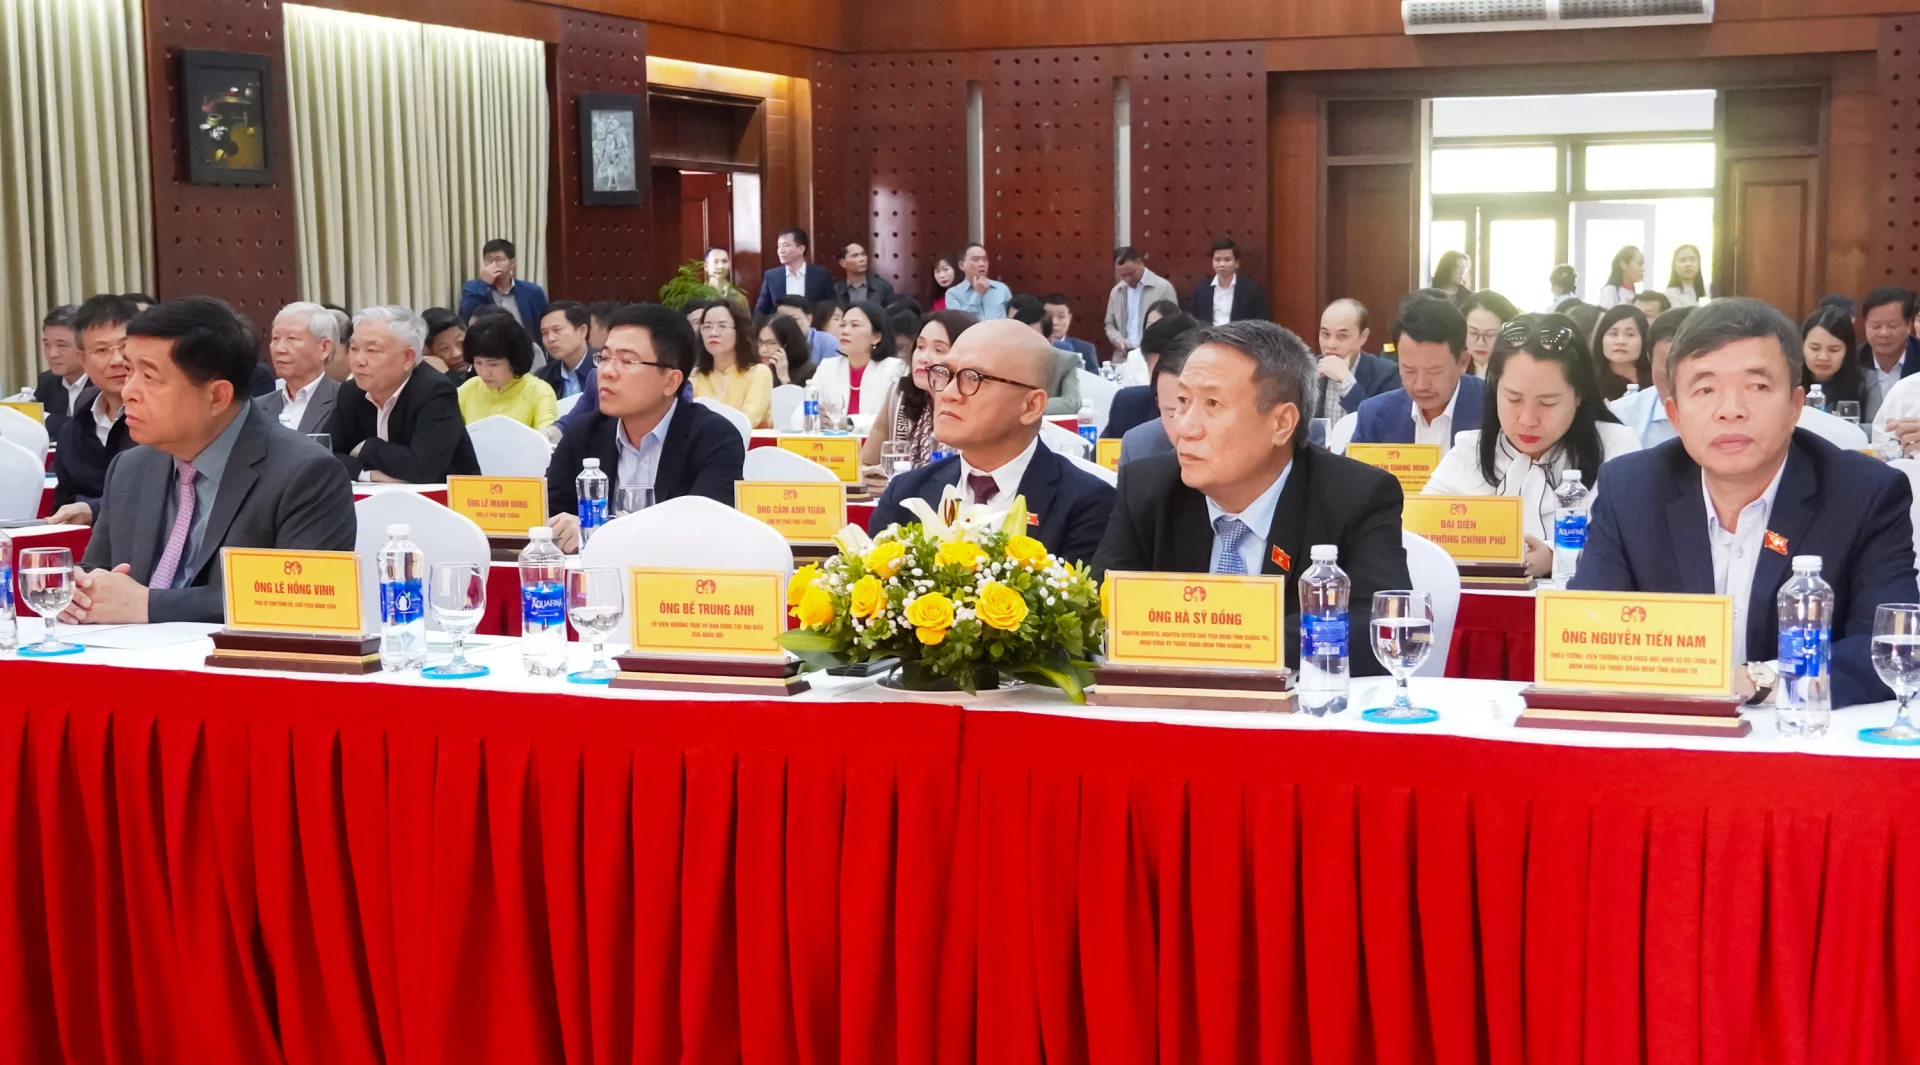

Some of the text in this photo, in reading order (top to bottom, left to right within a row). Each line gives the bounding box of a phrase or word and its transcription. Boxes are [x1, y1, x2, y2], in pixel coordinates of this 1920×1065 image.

[467, 498, 480, 507] ÔNG
[482, 498, 488, 507] LÊ
[757, 504, 771, 513] ÔNG
[1558, 528, 1584, 536] AQUAFINA
[254, 580, 272, 593] ÔNG
[275, 581, 284, 593] LÊ
[314, 585, 334, 596] VINH
[532, 597, 563, 609] AQUAFINA
[659, 600, 754, 616] ÔNG BẾ TRUNG ANH
[1148, 608, 1171, 622] ÔNG
[1175, 609, 1189, 623] HÀ
[1193, 610, 1207, 624] SỸ
[1562, 628, 1706, 648] ÔNG NGUYỄN TIẾN NAM
